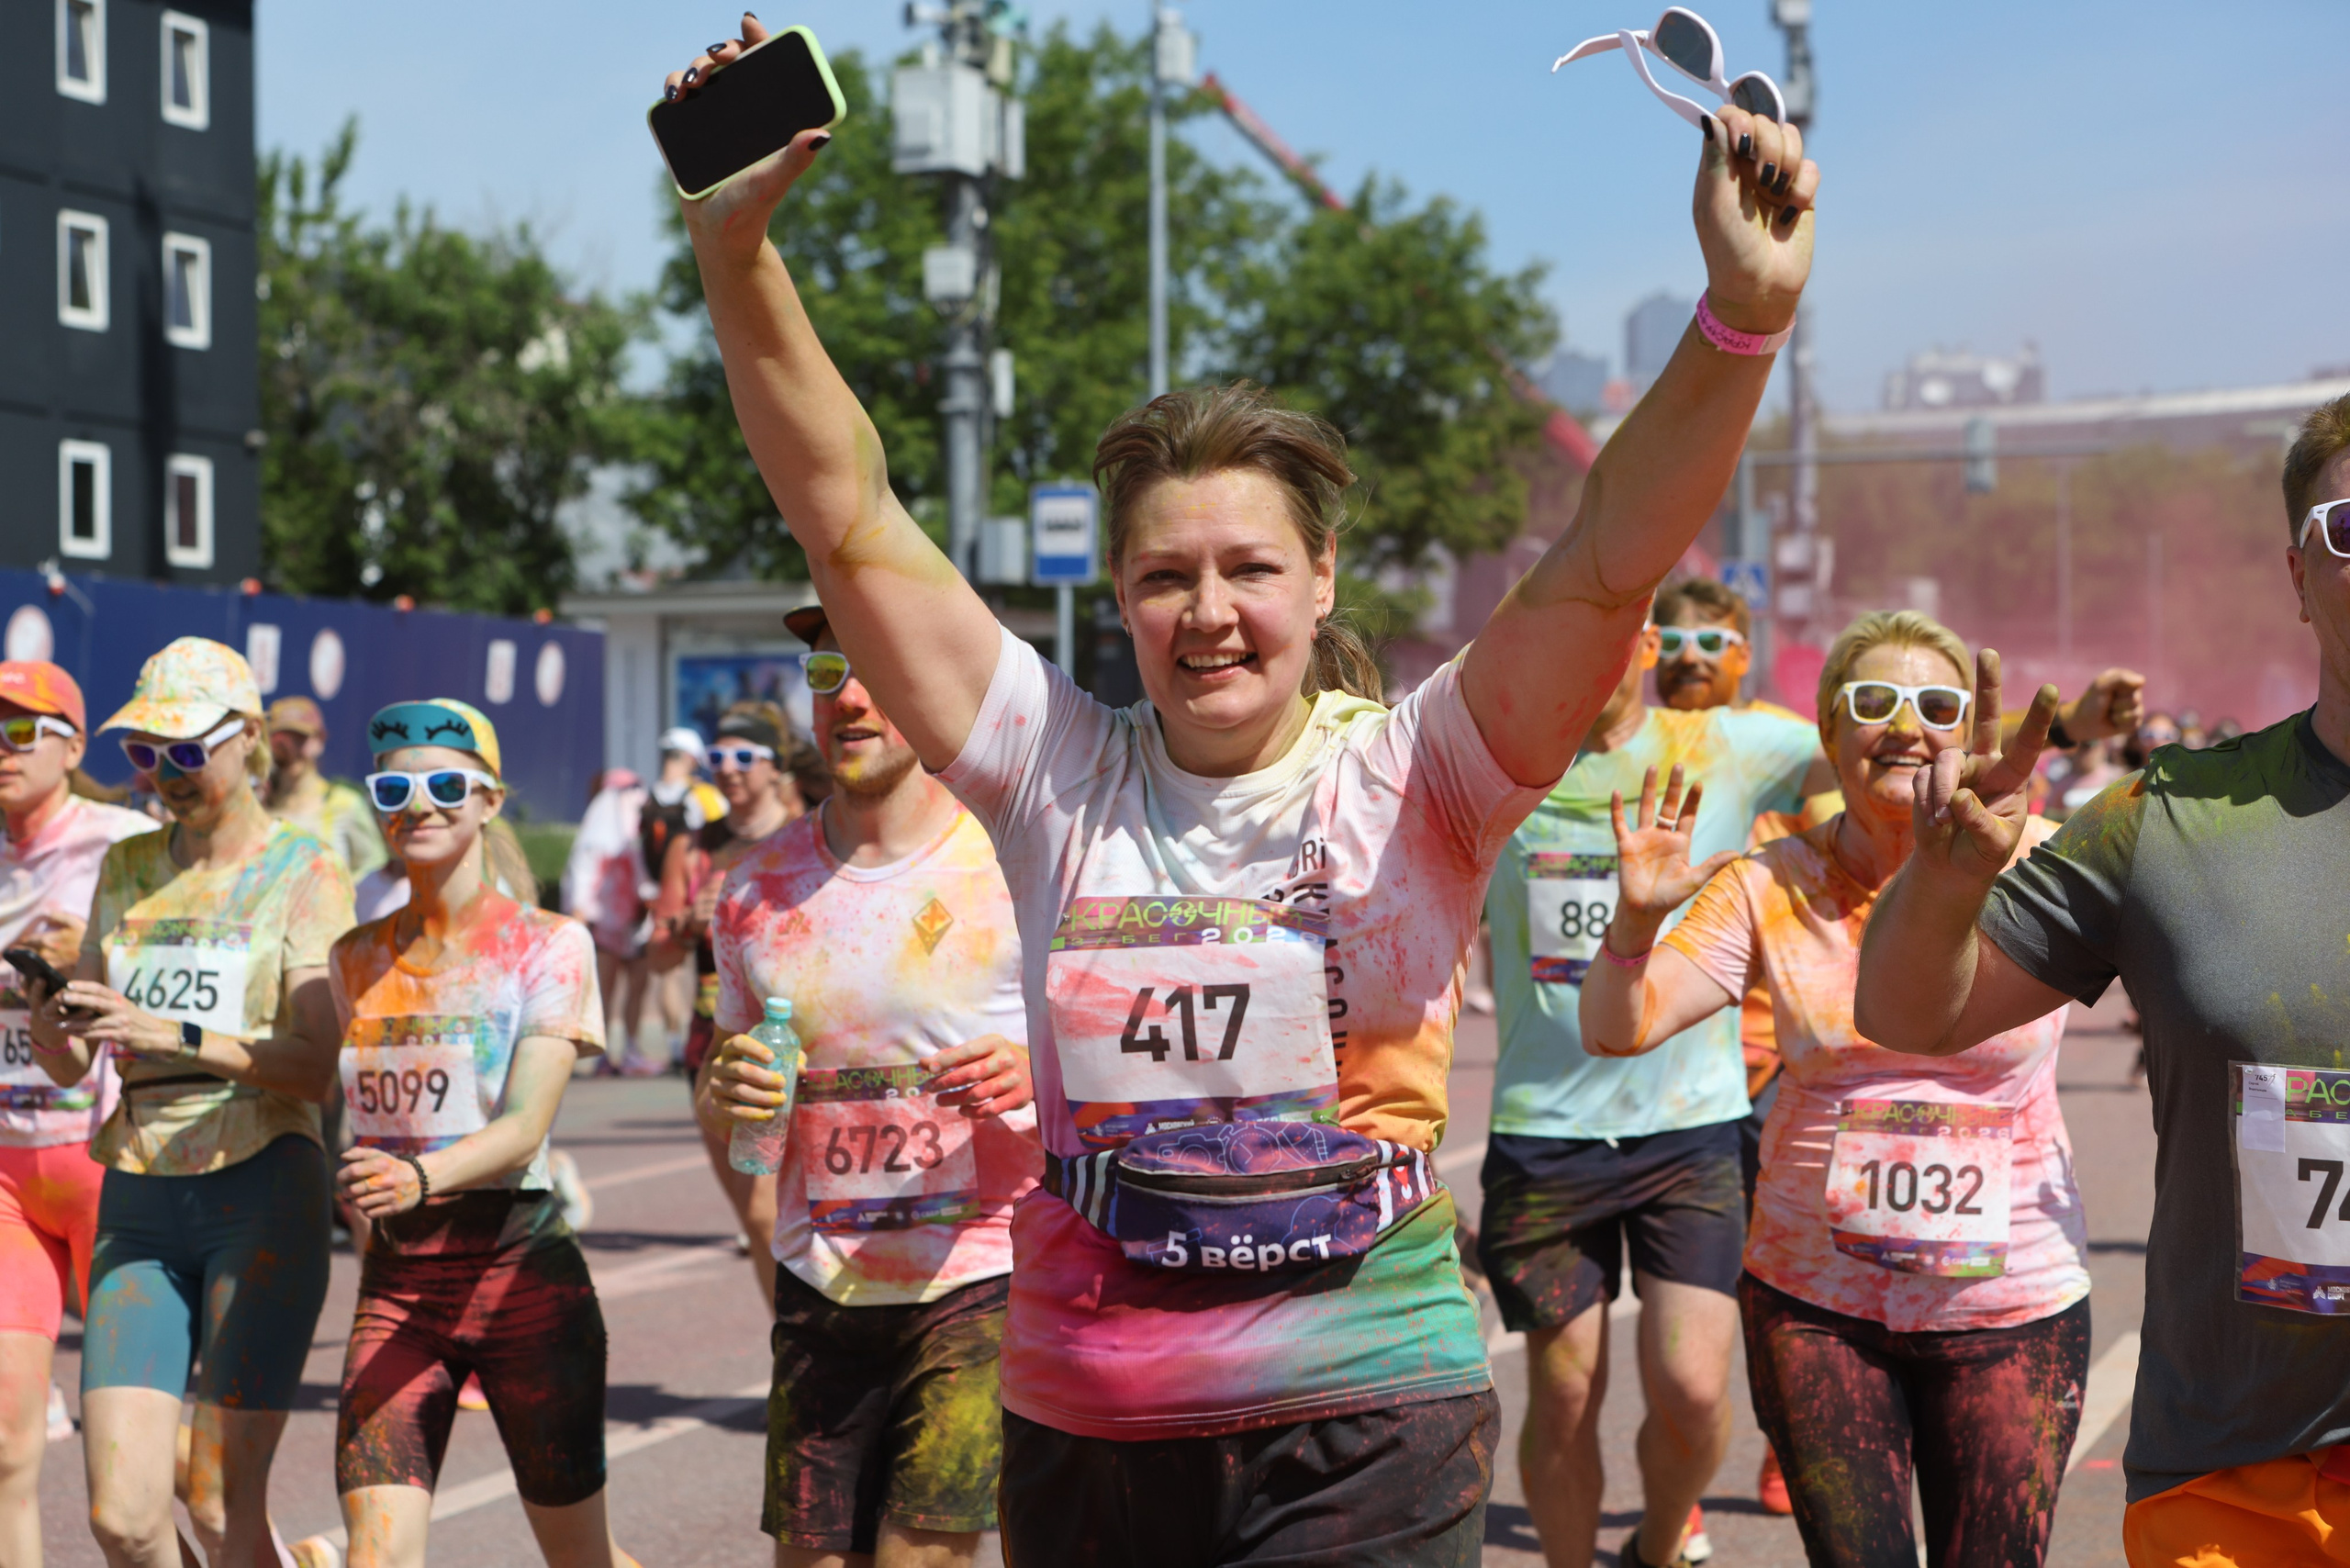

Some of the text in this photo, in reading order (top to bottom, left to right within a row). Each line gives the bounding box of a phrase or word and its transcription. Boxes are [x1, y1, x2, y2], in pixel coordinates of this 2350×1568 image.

[1070, 927, 1320, 947] ЗАБЕГ 2026
[1561, 900, 1608, 938] 88
[124, 967, 219, 1012] 4625
[1120, 983, 1250, 1062] 417
[4, 1027, 33, 1065] 65
[356, 1068, 450, 1114] 5099
[807, 1066, 934, 1092] КРАСОЧНЫ
[885, 1086, 920, 1100] 20
[825, 1120, 944, 1175] 6723
[1860, 1159, 1984, 1215] 1032
[1161, 1230, 1189, 1268] 5
